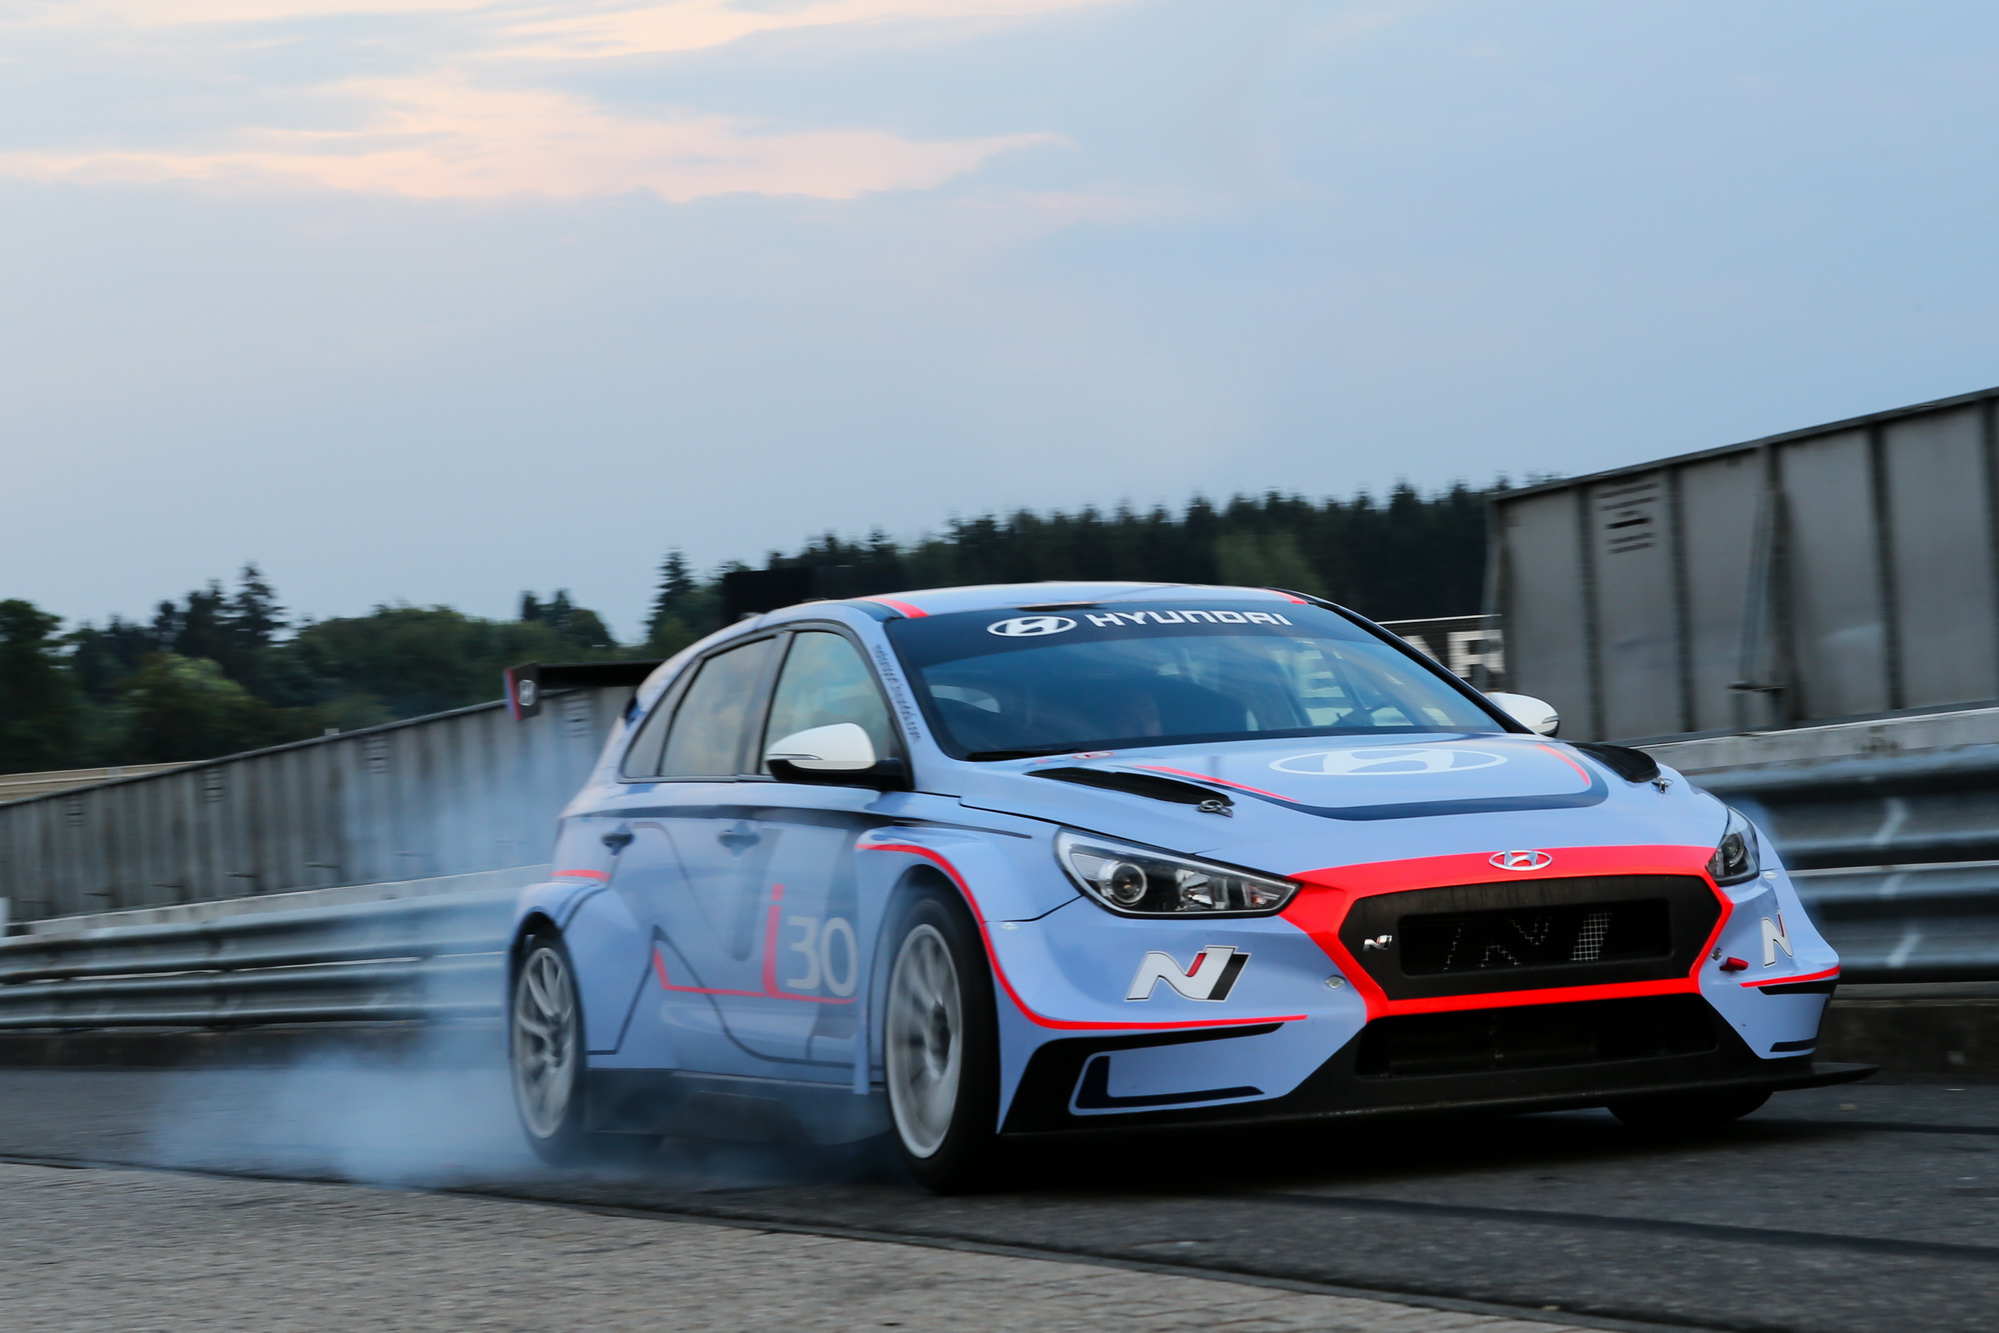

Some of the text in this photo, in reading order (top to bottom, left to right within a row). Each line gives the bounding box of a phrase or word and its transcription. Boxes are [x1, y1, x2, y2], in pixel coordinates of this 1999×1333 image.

[1084, 610, 1294, 628] HYUNDAI
[762, 883, 858, 1000] i30
[1124, 945, 1251, 1002] N
